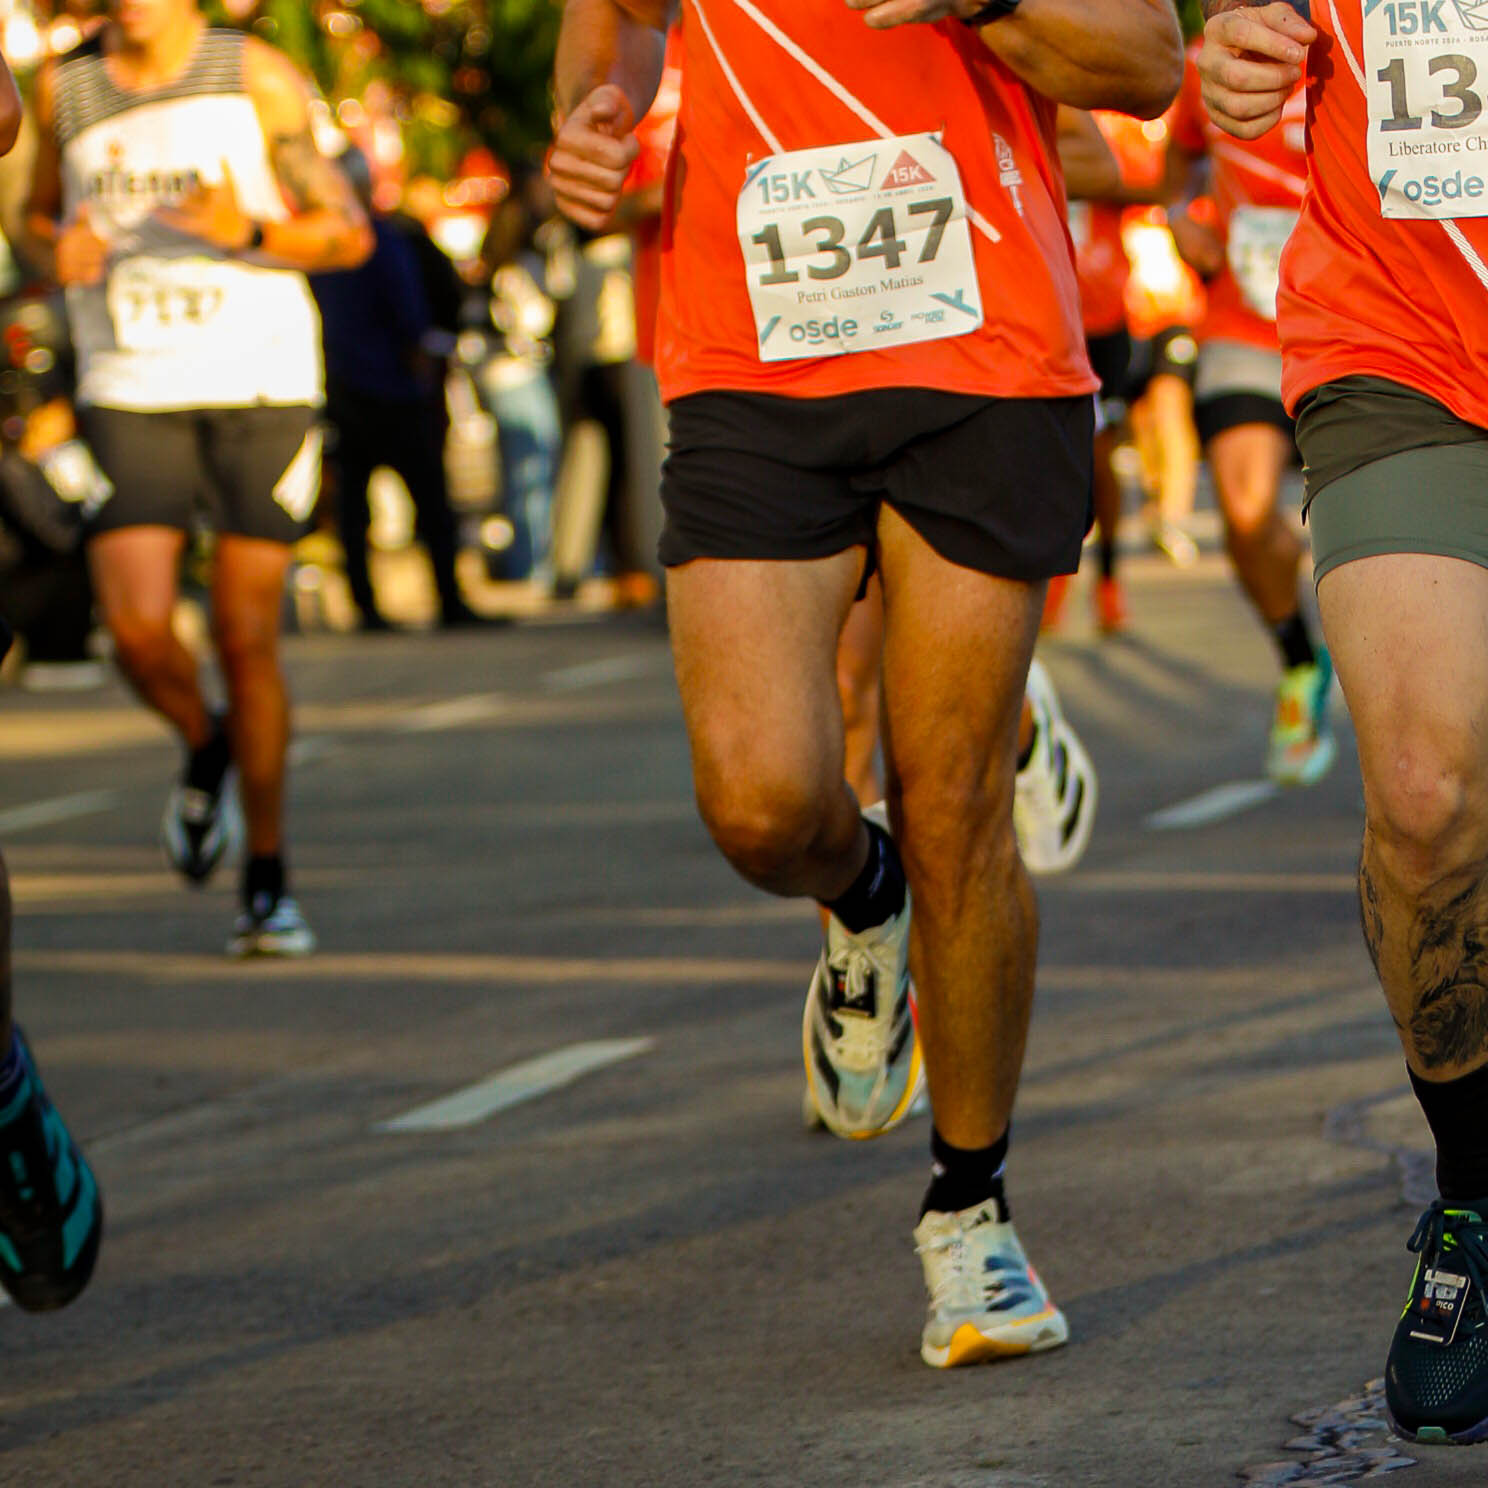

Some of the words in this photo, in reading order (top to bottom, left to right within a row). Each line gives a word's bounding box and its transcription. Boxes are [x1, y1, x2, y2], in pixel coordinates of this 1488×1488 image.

[1383, 0, 1448, 36] 15K
[1389, 139, 1461, 157] Liberatore
[757, 169, 816, 204] 15K
[891, 165, 924, 184] 15K
[1403, 169, 1485, 203] osde
[751, 197, 954, 286] 1347
[797, 287, 826, 304] Petri
[830, 283, 877, 301] Gaston
[789, 315, 858, 342] osde
